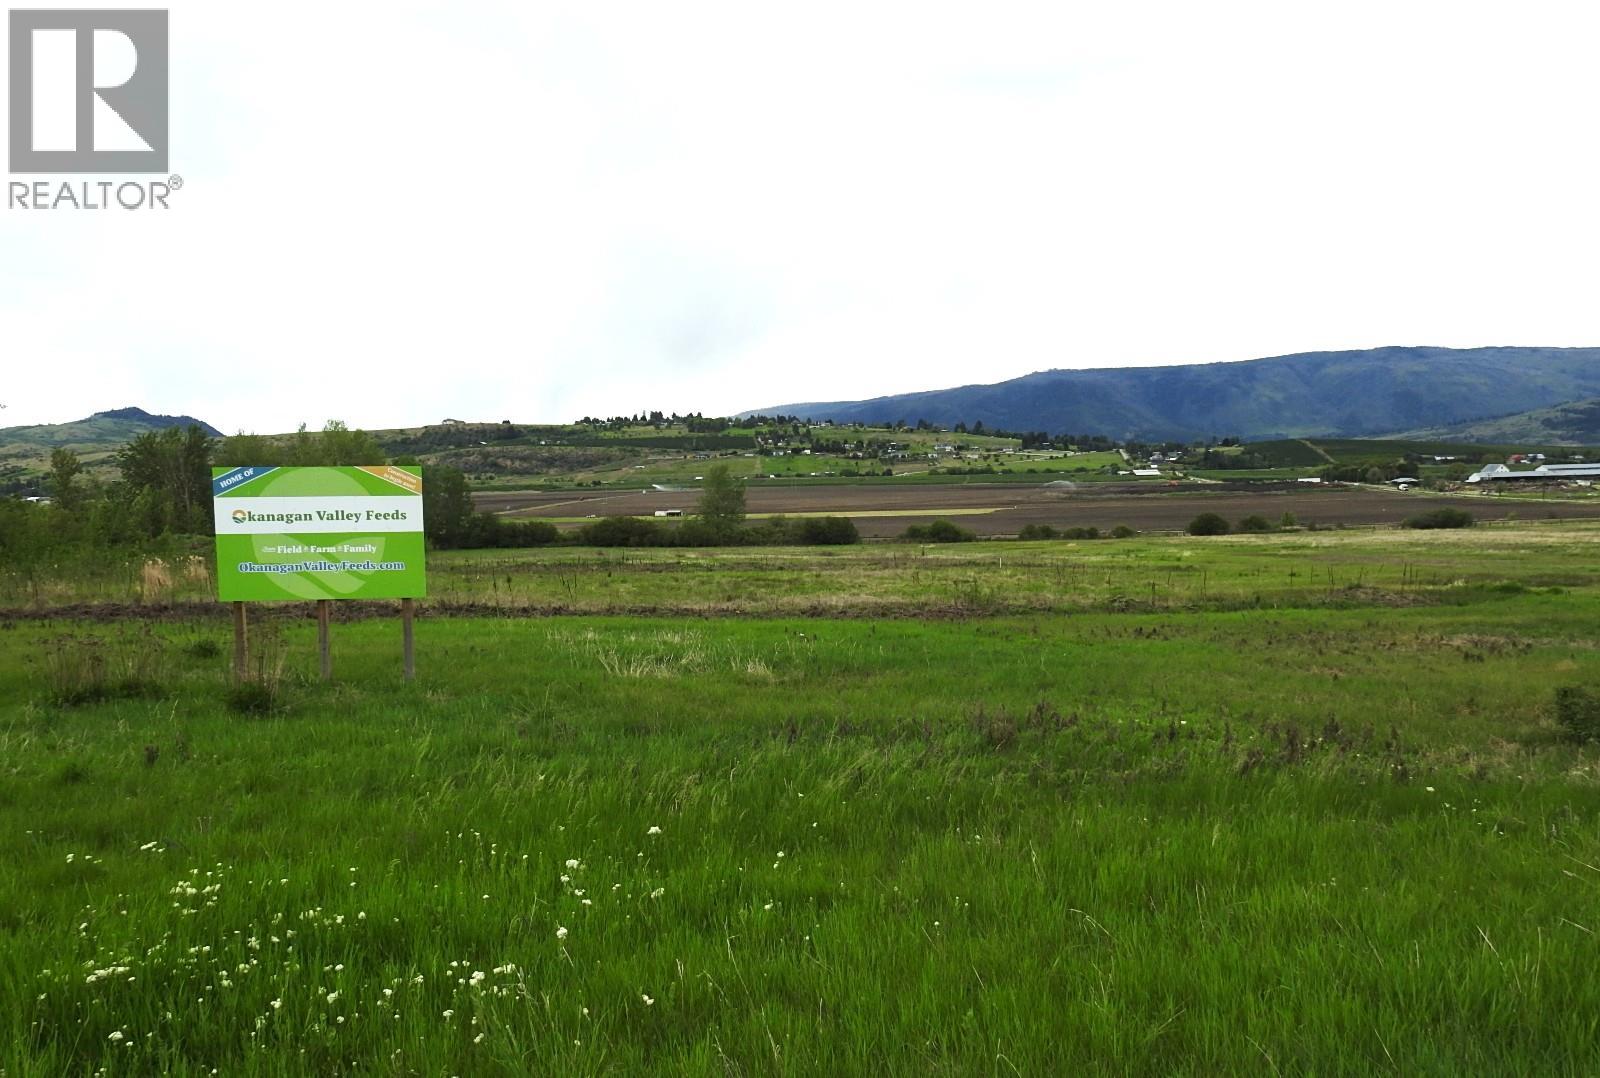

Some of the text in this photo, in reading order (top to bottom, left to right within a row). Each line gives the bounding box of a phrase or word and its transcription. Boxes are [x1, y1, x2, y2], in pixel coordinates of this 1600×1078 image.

[219, 467, 254, 488] HOME OF
[232, 509, 407, 524] Okanagan Valley Feeds
[277, 545, 302, 554] Field
[310, 545, 336, 553] Farm
[343, 544, 377, 554] Family
[238, 559, 405, 573] OkanaganValleyFeeds.com
